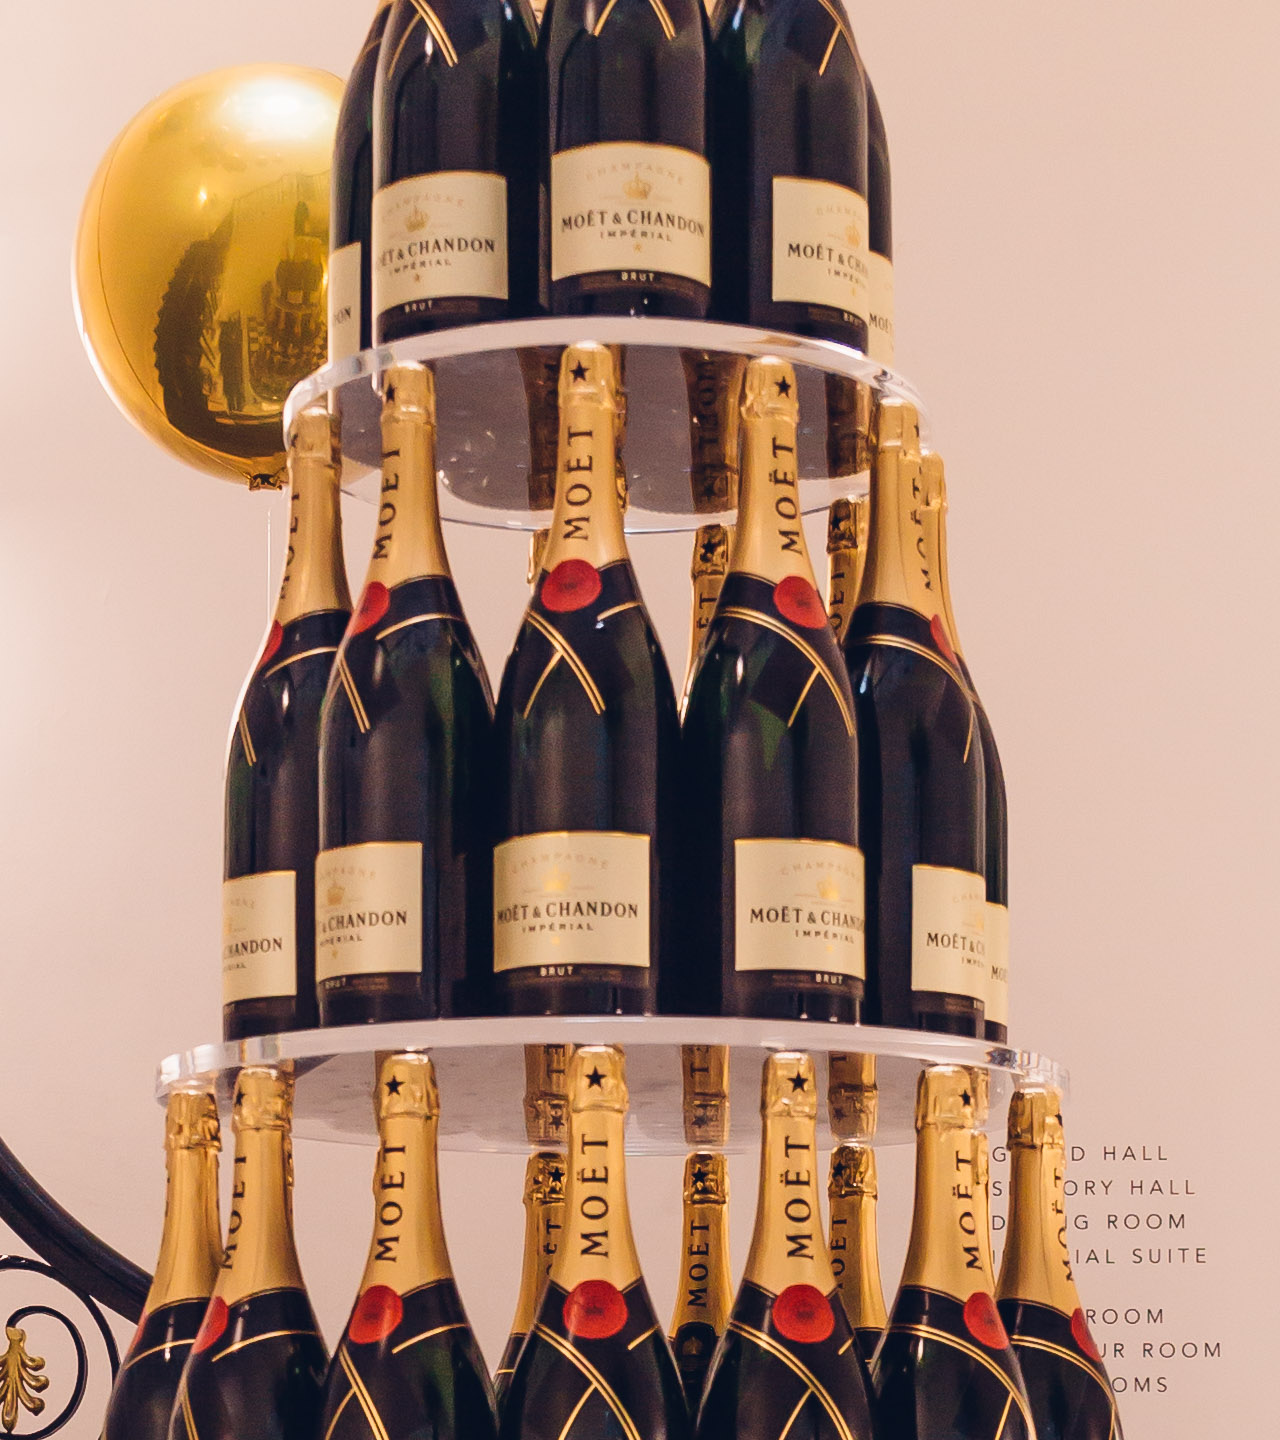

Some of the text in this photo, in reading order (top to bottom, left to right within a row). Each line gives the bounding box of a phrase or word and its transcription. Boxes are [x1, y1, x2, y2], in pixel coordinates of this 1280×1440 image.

[612, 213, 622, 224] &
[627, 210, 704, 238] CHANDON
[408, 237, 495, 257] CHANDON
[788, 243, 834, 261] MOËT
[621, 272, 655, 281] BRUT
[532, 905, 541, 918] &
[546, 901, 638, 919] CHANDON
[750, 906, 802, 924] MOËT
[807, 912, 816, 924] &
[328, 910, 408, 931] CHANDON
[540, 966, 574, 977] BRUT
[816, 974, 842, 985] BRUT
[1103, 1146, 1168, 1161] HALL
[577, 1133, 610, 1258] MOËT
[1130, 1180, 1196, 1195] HALL
[779, 1135, 813, 1260] MOËT
[1108, 1214, 1186, 1230] ROOM
[1132, 1248, 1207, 1264] SUITE
[1086, 1309, 1164, 1324] ROOM
[1143, 1343, 1221, 1358] ROOM
